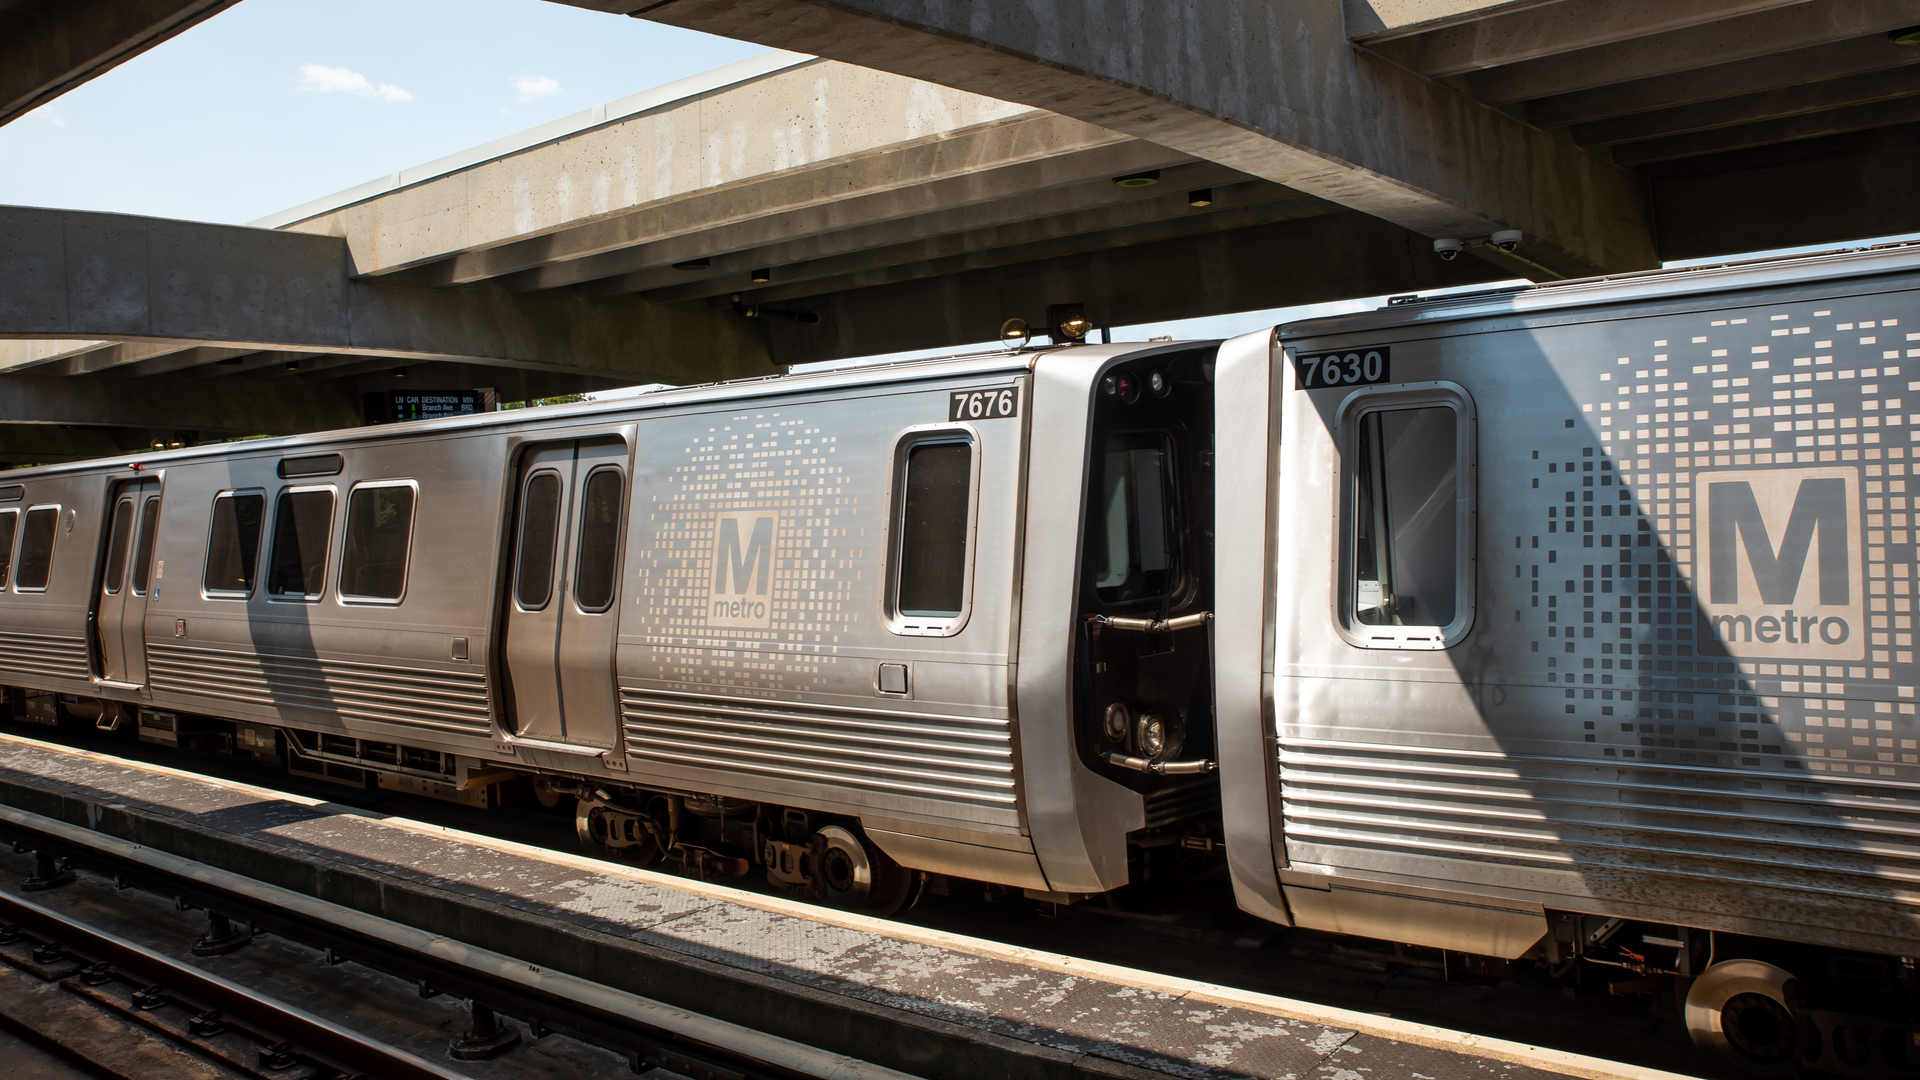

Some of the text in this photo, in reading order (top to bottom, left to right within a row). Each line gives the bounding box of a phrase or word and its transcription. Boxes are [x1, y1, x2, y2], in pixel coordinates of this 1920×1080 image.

[1302, 351, 1382, 387] 7630
[395, 396, 474, 404] LN CAR DESTINATION MIN
[410, 403, 416, 411] 8
[461, 403, 473, 411] BRD
[955, 389, 1013, 419] 7676
[411, 412, 417, 420] 8
[714, 516, 774, 596] M
[1708, 477, 1850, 606] M
[713, 597, 766, 620] metro
[1712, 609, 1850, 645] metro
